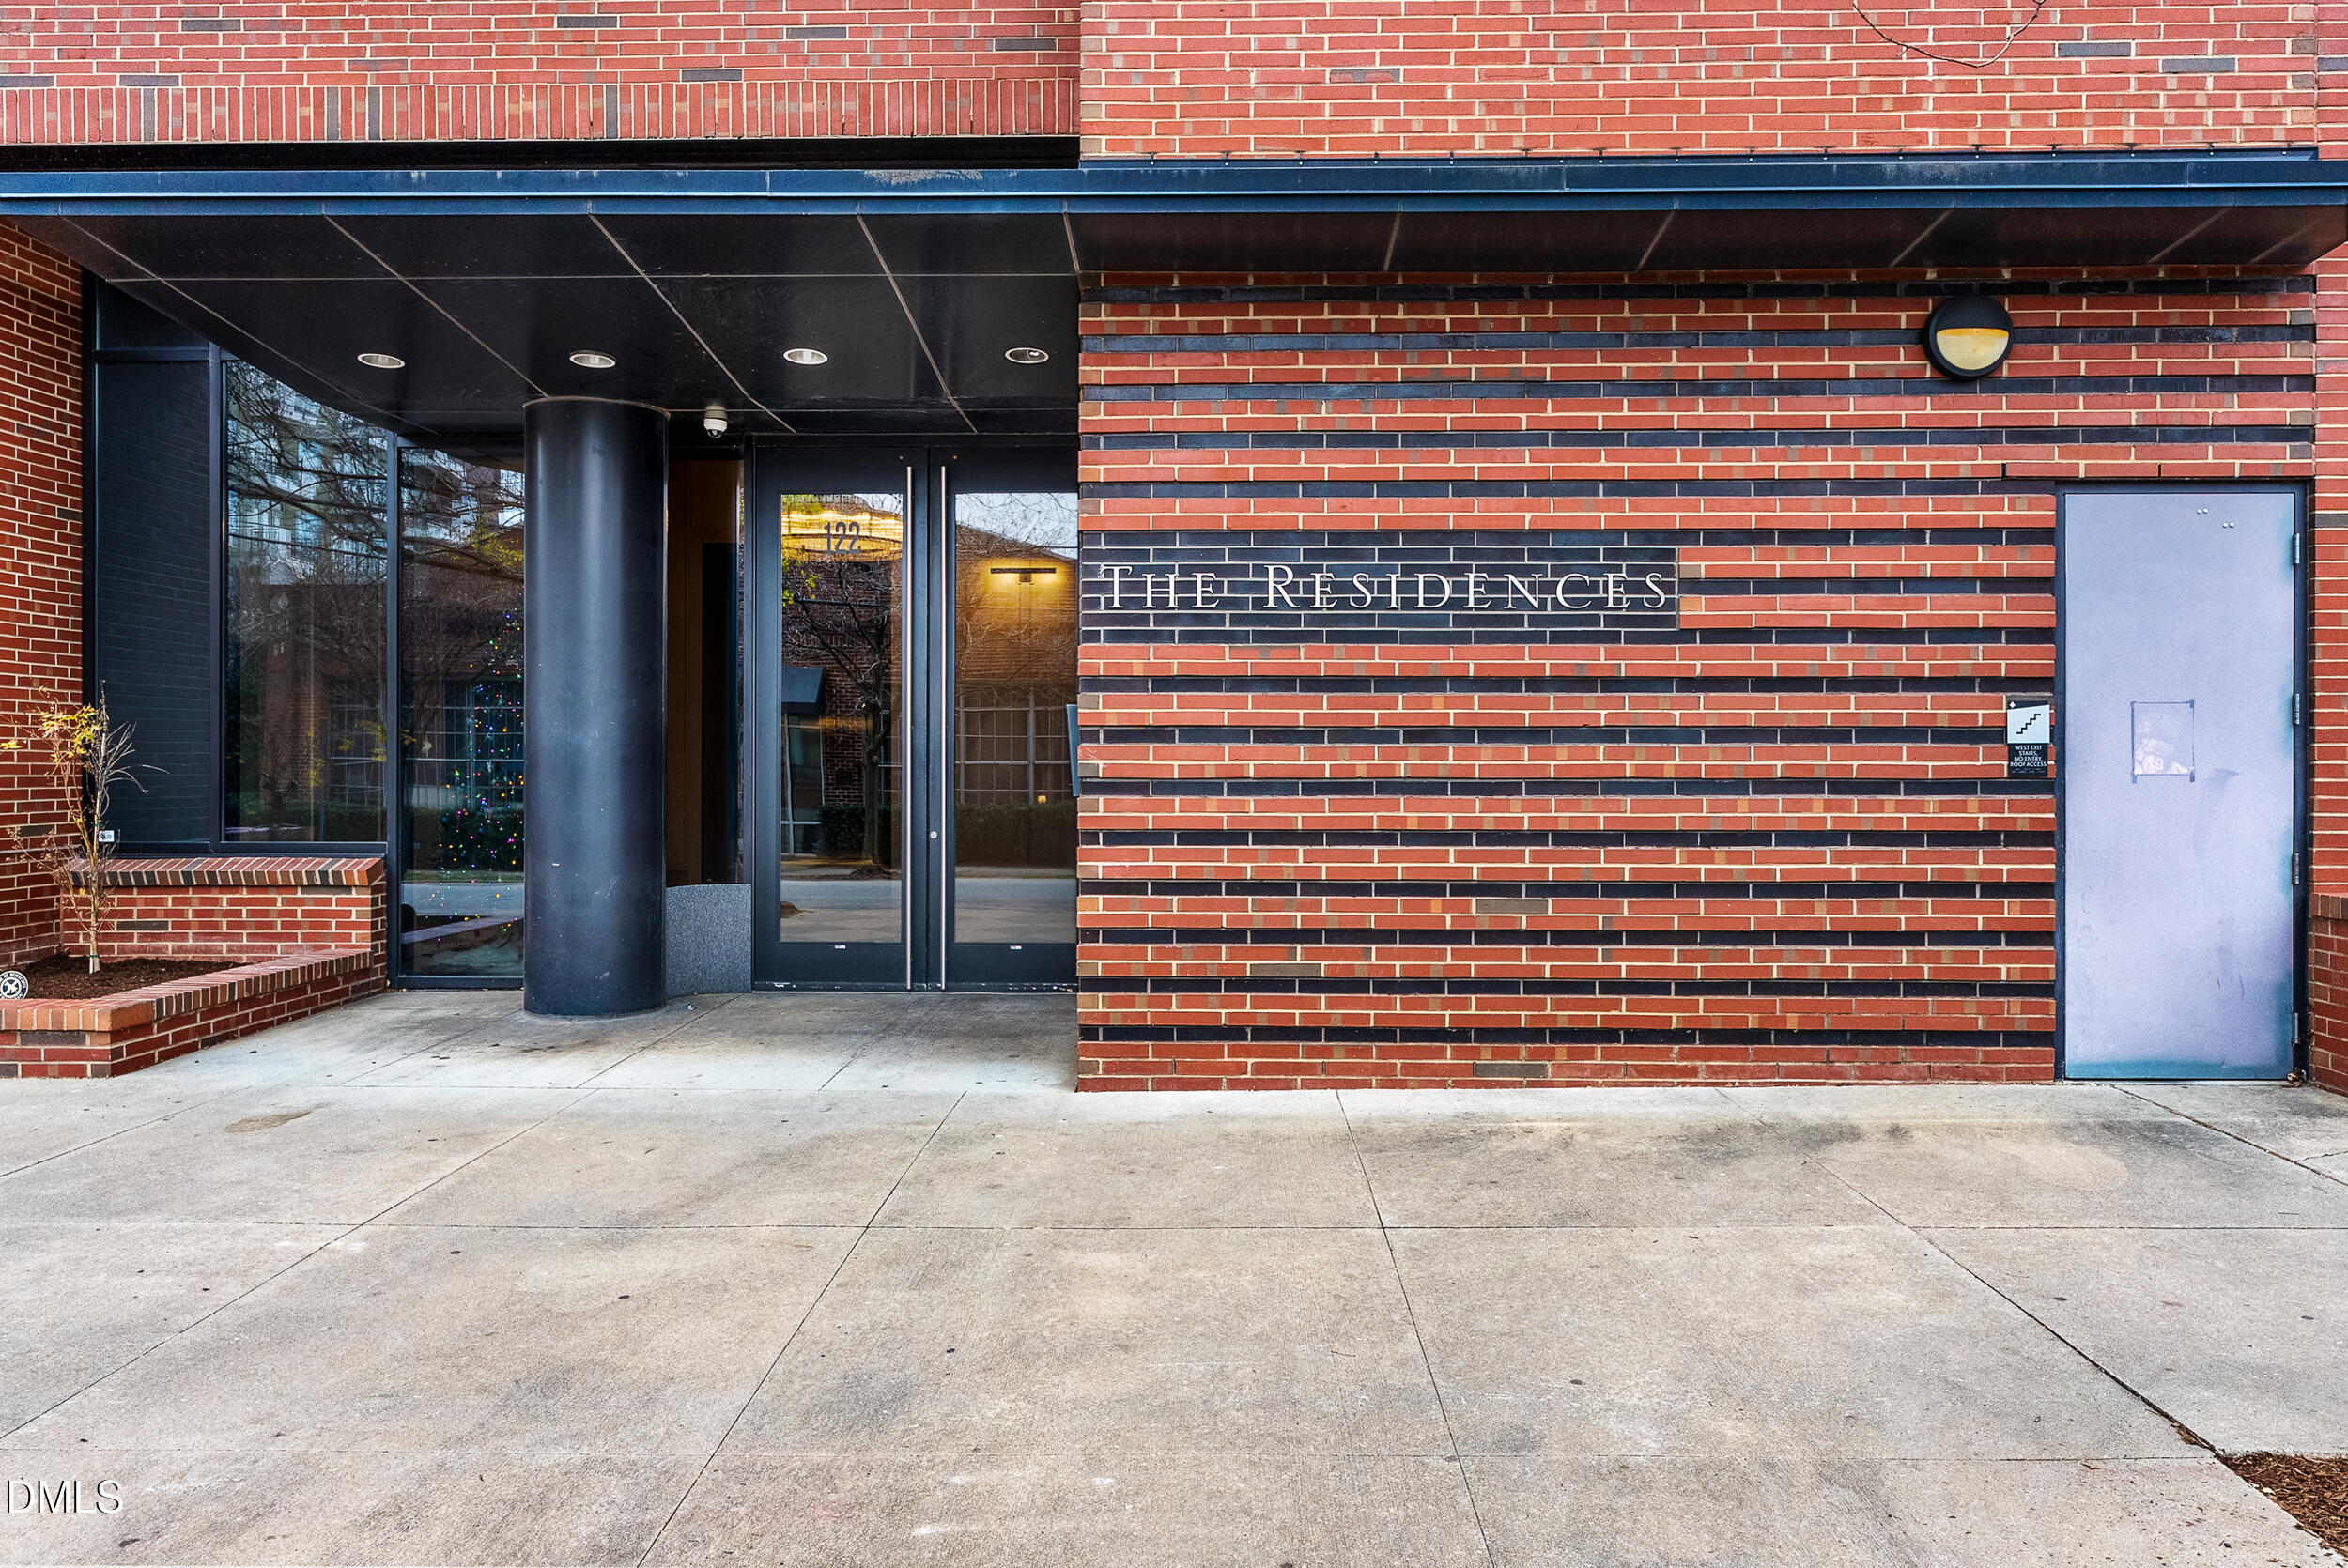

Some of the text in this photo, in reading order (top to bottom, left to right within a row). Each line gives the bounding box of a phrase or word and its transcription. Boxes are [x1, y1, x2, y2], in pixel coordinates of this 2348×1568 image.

[824, 521, 860, 555] 122
[1100, 564, 1667, 611] THE RESIDENCES
